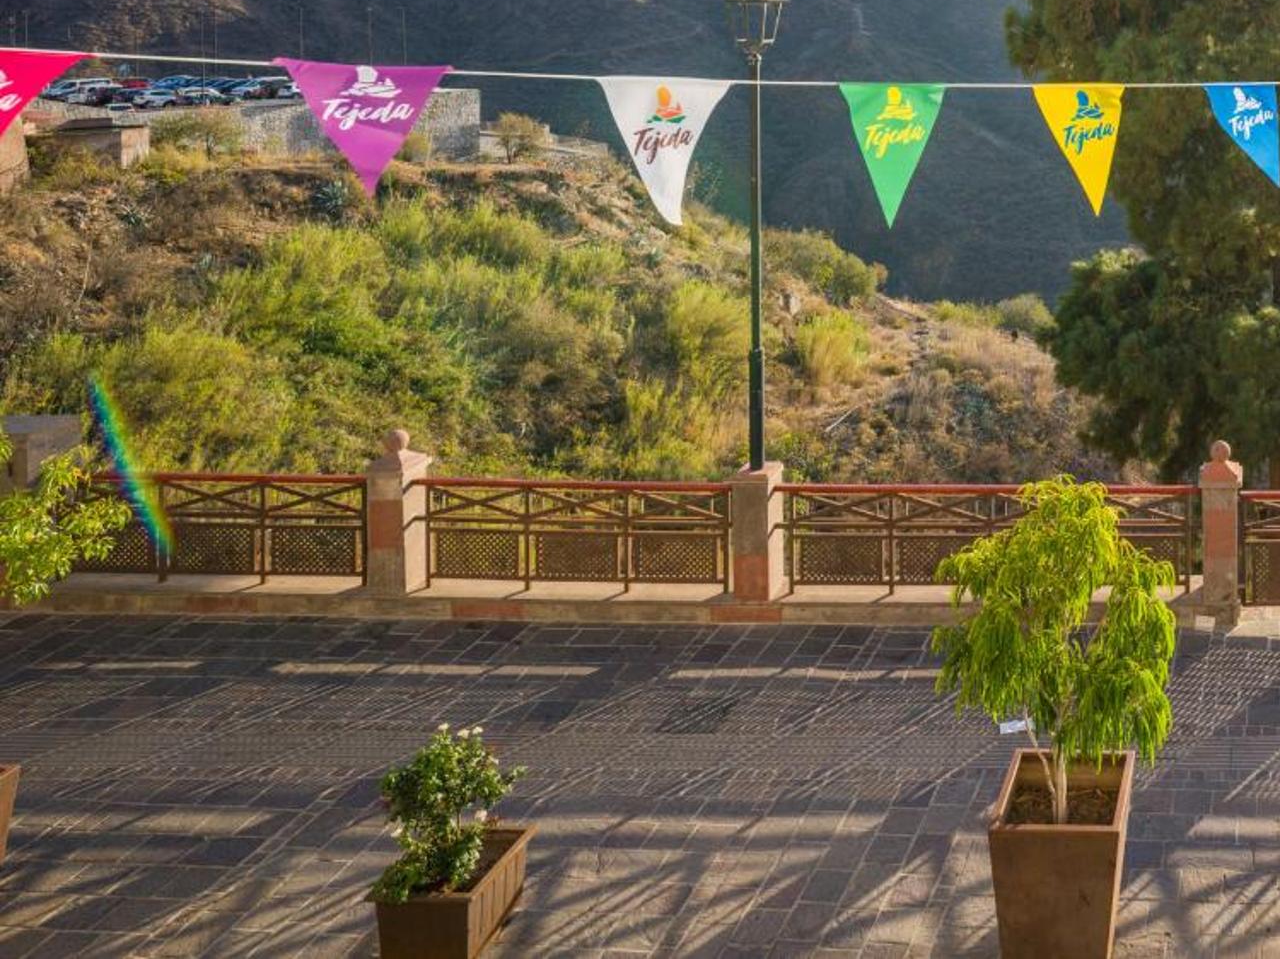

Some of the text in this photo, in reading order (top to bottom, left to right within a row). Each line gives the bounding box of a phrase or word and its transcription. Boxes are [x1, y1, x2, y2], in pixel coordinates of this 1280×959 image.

[322, 98, 415, 131] Tejeda
[1228, 108, 1274, 141] Tejeda
[633, 127, 694, 165] Tejeda
[864, 122, 926, 160] Tejeda
[1063, 122, 1115, 155] Tejeda
